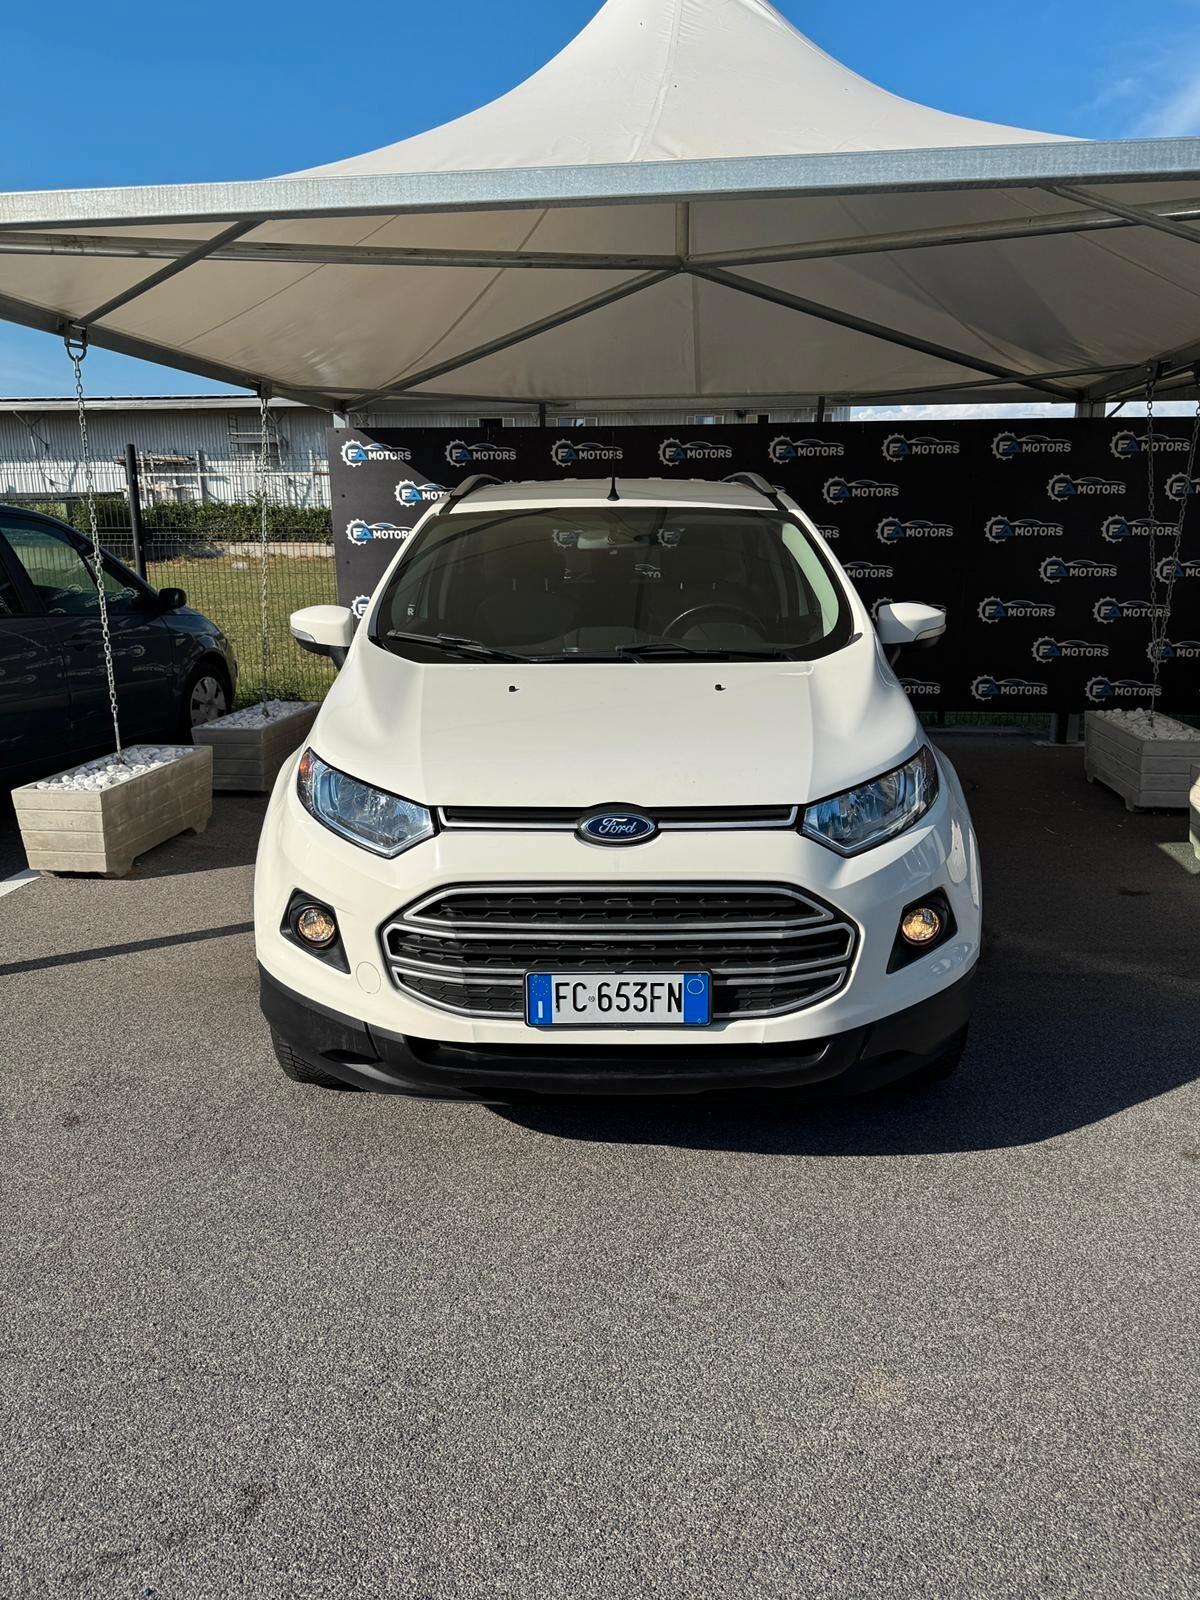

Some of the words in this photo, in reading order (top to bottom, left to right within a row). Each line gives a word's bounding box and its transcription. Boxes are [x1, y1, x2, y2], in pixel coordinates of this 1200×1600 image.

[798, 446, 845, 456] MOTORS
[912, 444, 960, 454] MOTORS
[1022, 443, 1072, 453] MOTORS
[1141, 442, 1190, 451] MOTORS
[368, 452, 411, 460] MOTORS
[473, 452, 517, 460] MOTORS
[579, 450, 623, 460] MOTORS
[687, 449, 732, 459] MOTORS
[852, 487, 899, 497] MOTORS
[1077, 484, 1126, 494] MOTORS
[905, 527, 954, 537] MOTORS
[1015, 526, 1063, 536] MOTORS
[1132, 526, 1180, 536] MOTORS
[847, 569, 893, 578] MOTORS
[1069, 567, 1117, 577] MOTORS
[1007, 607, 1055, 617] MOTORS
[1122, 608, 1170, 617] MOTORS
[1061, 647, 1109, 657] MOTORS
[1000, 685, 1048, 695] MOTORS
[1114, 687, 1162, 697] MOTORS
[598, 817, 638, 834] Ford
